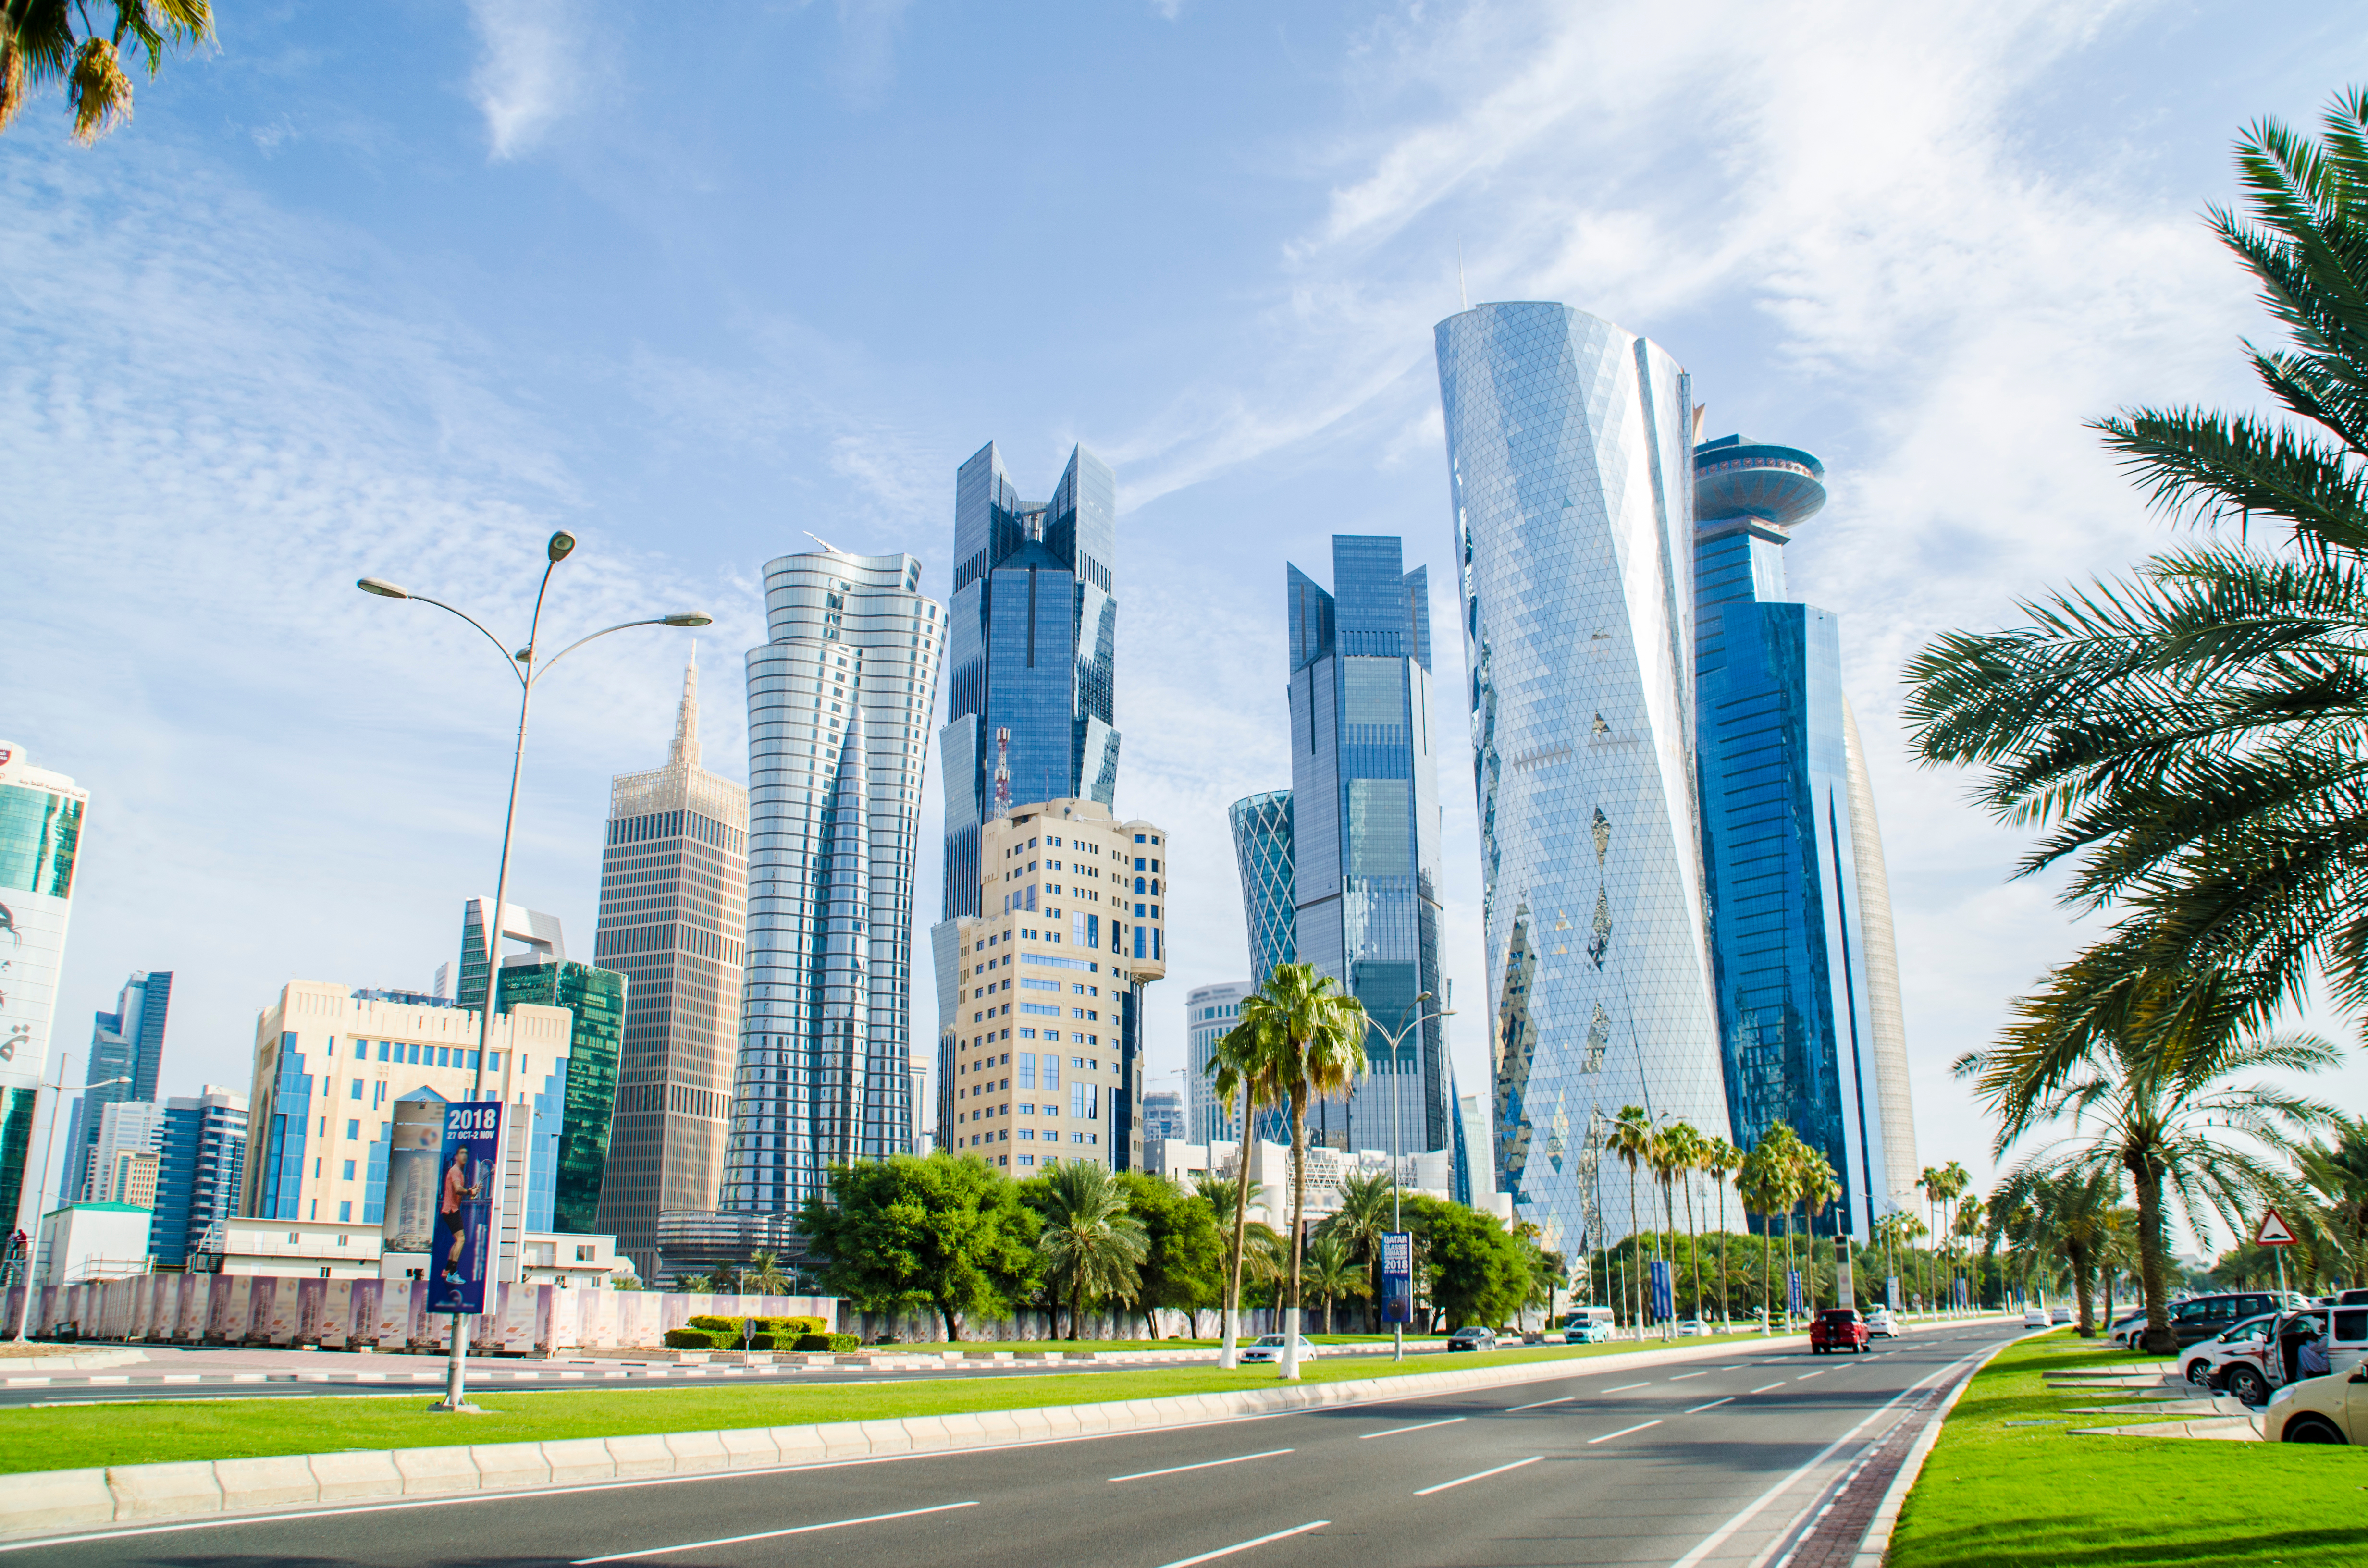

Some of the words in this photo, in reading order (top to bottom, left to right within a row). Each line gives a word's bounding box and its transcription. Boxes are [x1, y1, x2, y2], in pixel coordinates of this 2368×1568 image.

[448, 1109, 496, 1130] 2018
[446, 1131, 457, 1139] 27
[457, 1131, 479, 1139] OCT-2
[480, 1130, 495, 1139] NOV
[1384, 1235, 1407, 1244] QATAR
[1384, 1259, 1408, 1269] 2018
